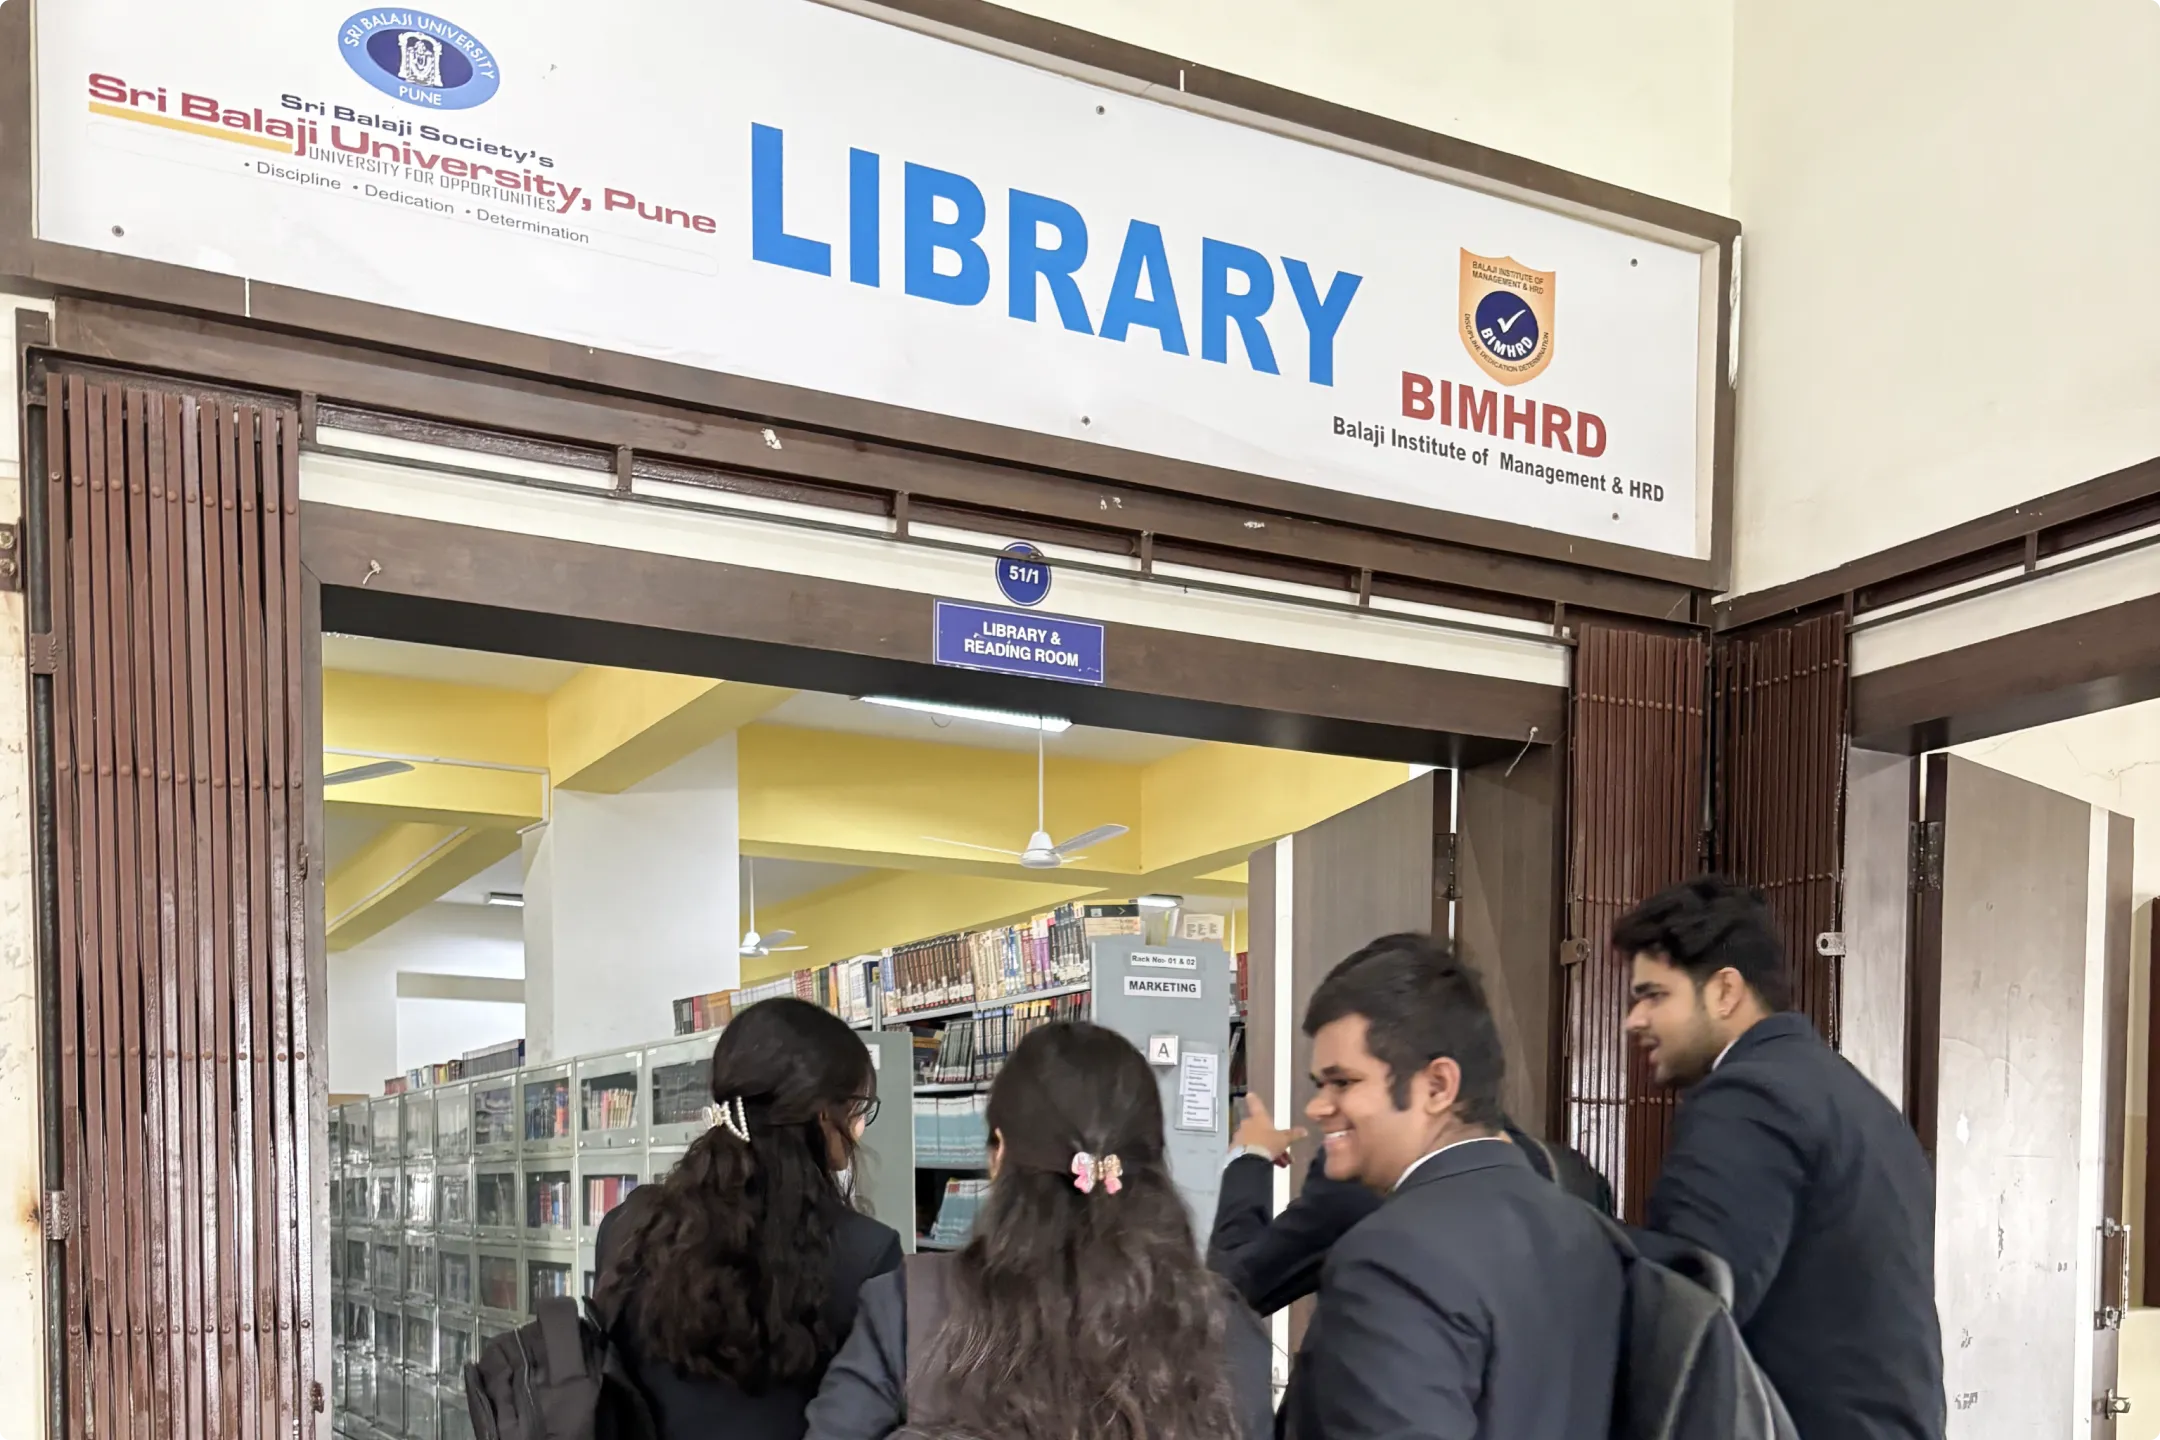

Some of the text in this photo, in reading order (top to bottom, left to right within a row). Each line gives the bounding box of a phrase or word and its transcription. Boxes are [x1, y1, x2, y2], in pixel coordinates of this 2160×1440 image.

[344, 13, 495, 80] SRI BALAJI UNIVERSITY
[399, 85, 442, 105] PUNE
[281, 93, 554, 168] Sri Balaji Society's
[89, 73, 716, 234] Sri Balaji University, Pune
[309, 146, 556, 212] UNIVERSITY FOR OPPORTUNITIES
[257, 161, 589, 244] Discipline Dedication Determination
[752, 122, 1364, 387] LIBRARY
[1472, 261, 1544, 285] BALAJI INSTITUTE OF
[1472, 270, 1544, 295] MANAGEMENT & HRD
[1464, 313, 1549, 373] DISCIPLINE DEDICATION DETERMINATION
[1481, 327, 1533, 358] BIMHRD
[1401, 371, 1607, 458] BIMHRD
[1333, 415, 1664, 502] Balaji Institute of Management & HRD
[1009, 565, 1039, 584] 51/1
[983, 621, 1061, 645] LIBRARY &
[964, 638, 1078, 667] READING ROOM
[1132, 955, 1150, 963] Rack
[1129, 980, 1197, 993] MARKETING
[1157, 1042, 1170, 1058] A
